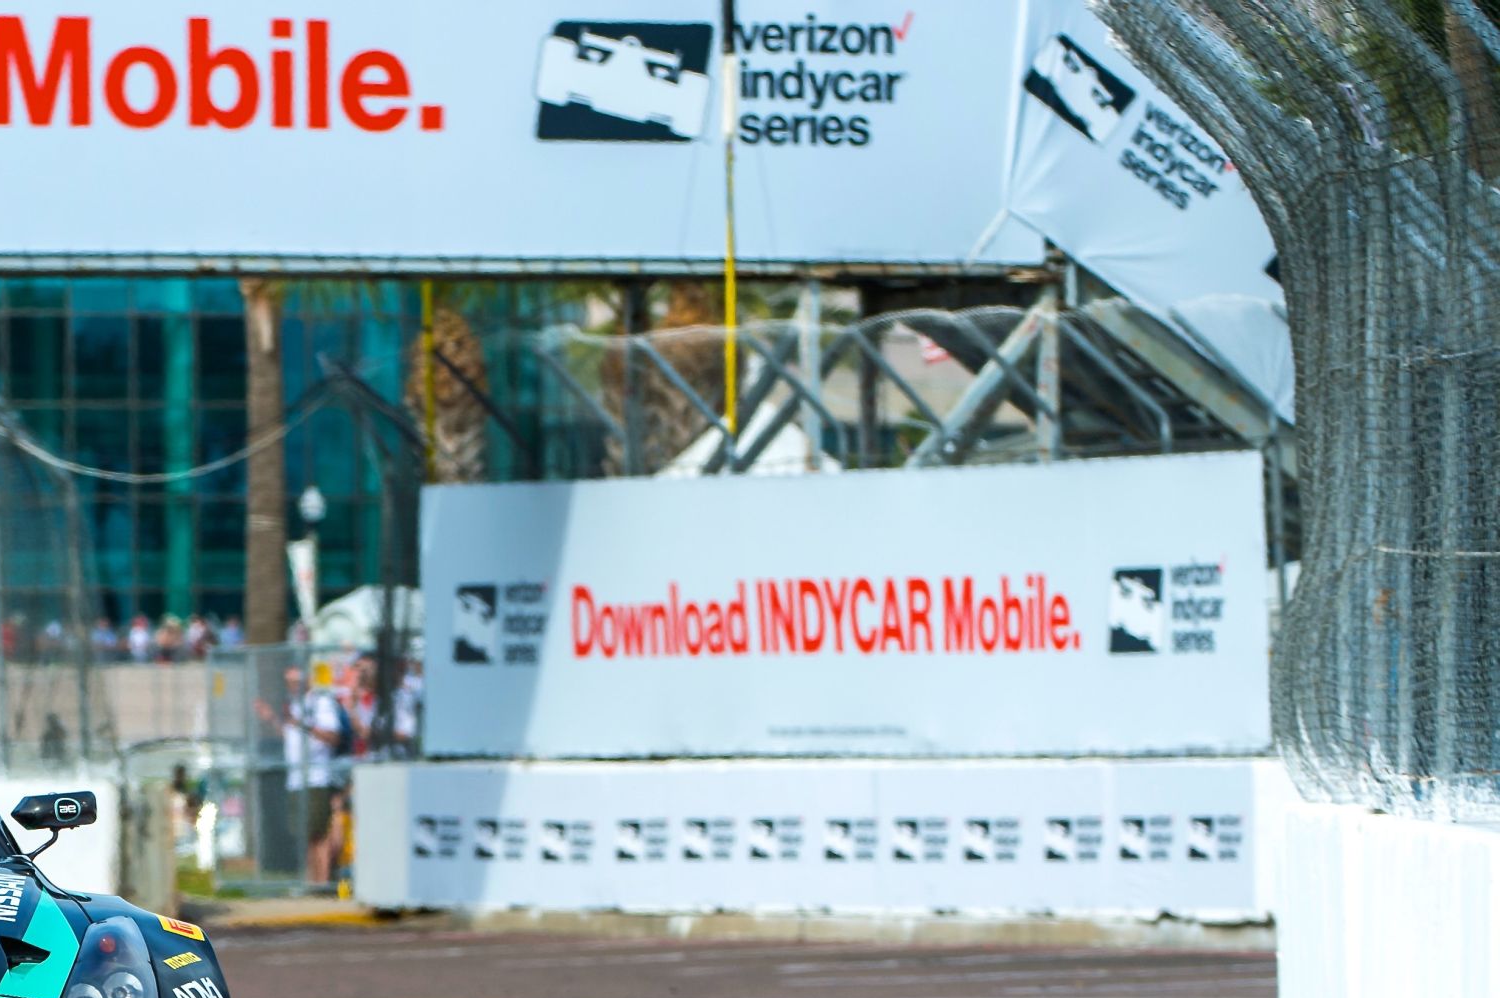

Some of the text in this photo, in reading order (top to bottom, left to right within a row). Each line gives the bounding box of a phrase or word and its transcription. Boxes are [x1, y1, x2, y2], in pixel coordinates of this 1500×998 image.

[734, 14, 894, 55] verizon
[740, 58, 904, 110] indycar
[739, 113, 871, 146] series
[1131, 122, 1219, 197] indycar
[1145, 102, 1225, 174] verizon
[572, 574, 1082, 658] Download INDYCAR Mobile.
